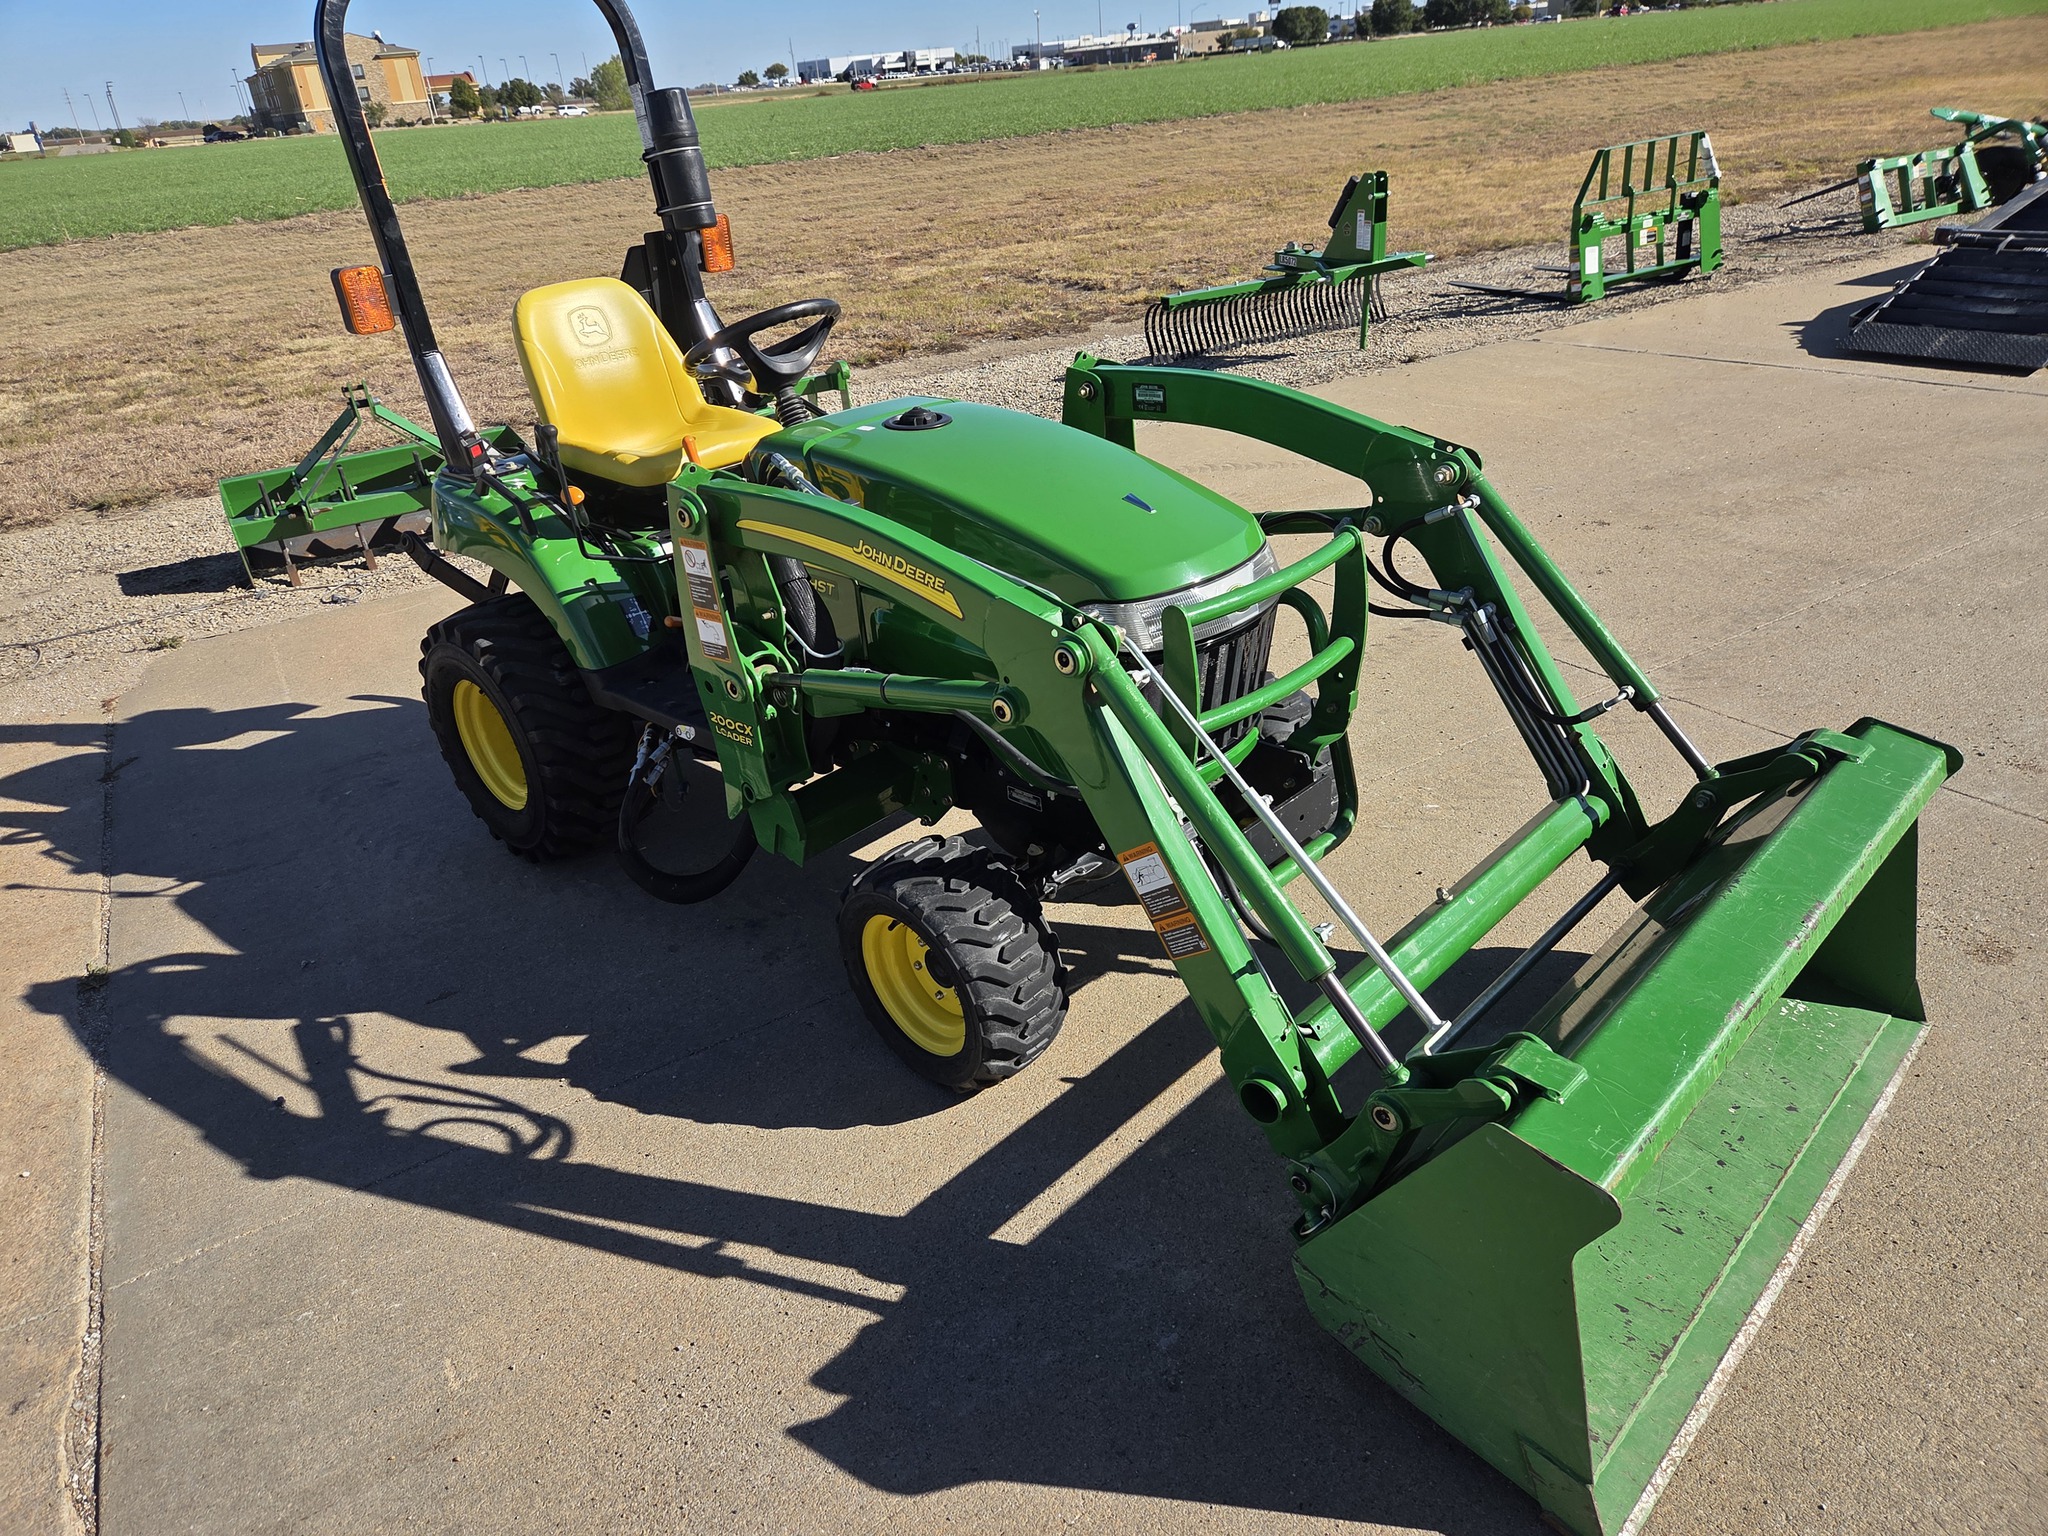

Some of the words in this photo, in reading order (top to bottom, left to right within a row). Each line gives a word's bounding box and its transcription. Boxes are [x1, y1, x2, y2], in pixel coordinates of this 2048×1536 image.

[570, 354, 600, 369] OHN
[853, 540, 892, 568] JOHN
[893, 556, 945, 592] DEERE
[709, 711, 753, 737] 200CX
[715, 725, 753, 747] LOADER
[1129, 846, 1153, 857] WARNING
[1166, 917, 1191, 928] WARNING
